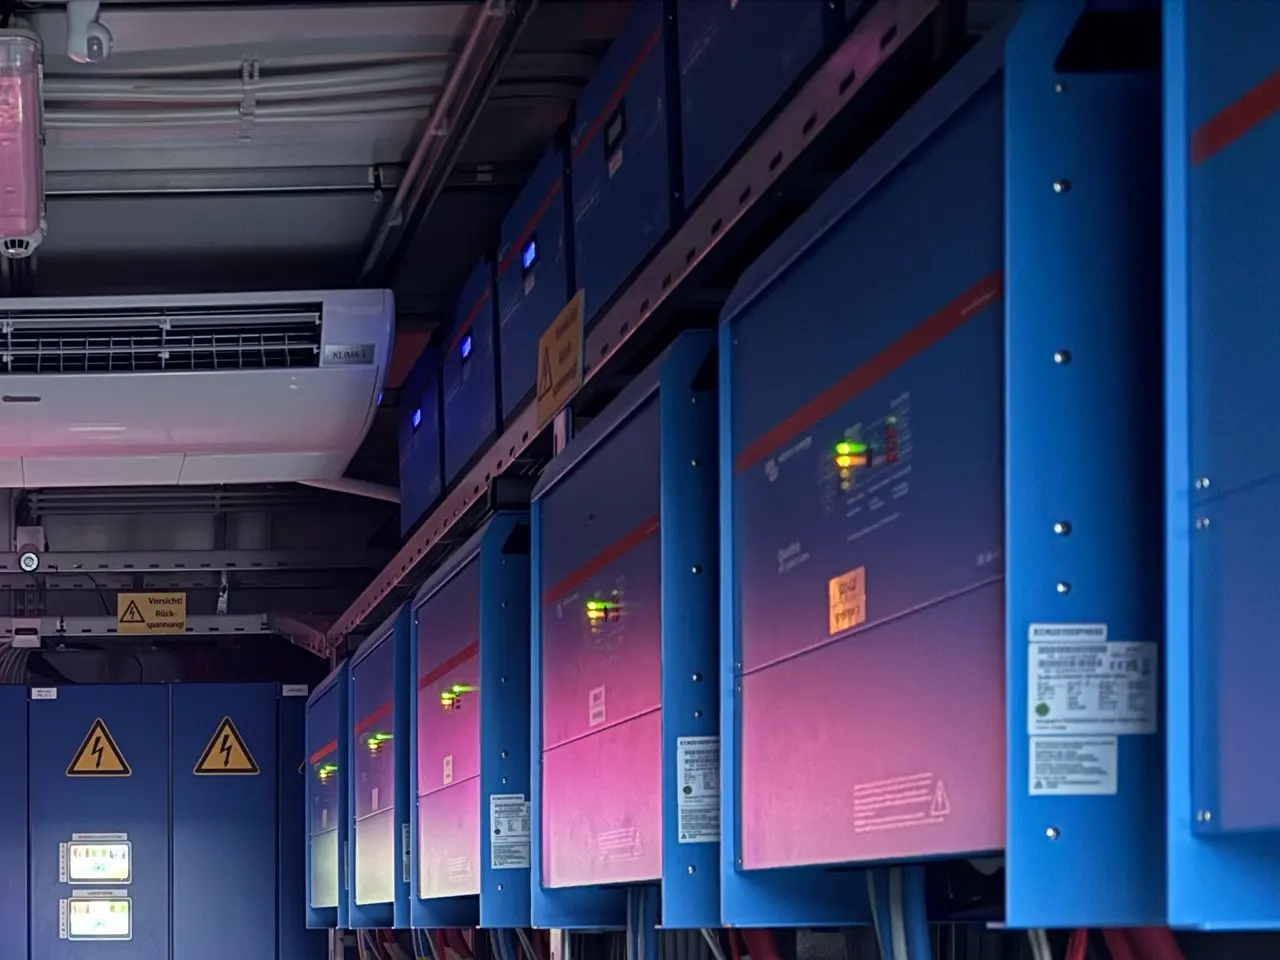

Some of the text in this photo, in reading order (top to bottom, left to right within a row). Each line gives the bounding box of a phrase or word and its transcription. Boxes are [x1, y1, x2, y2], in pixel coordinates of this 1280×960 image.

[148, 597, 183, 605] Vorsicht!
[155, 609, 178, 617] Rück-
[146, 621, 185, 630] spannung!
